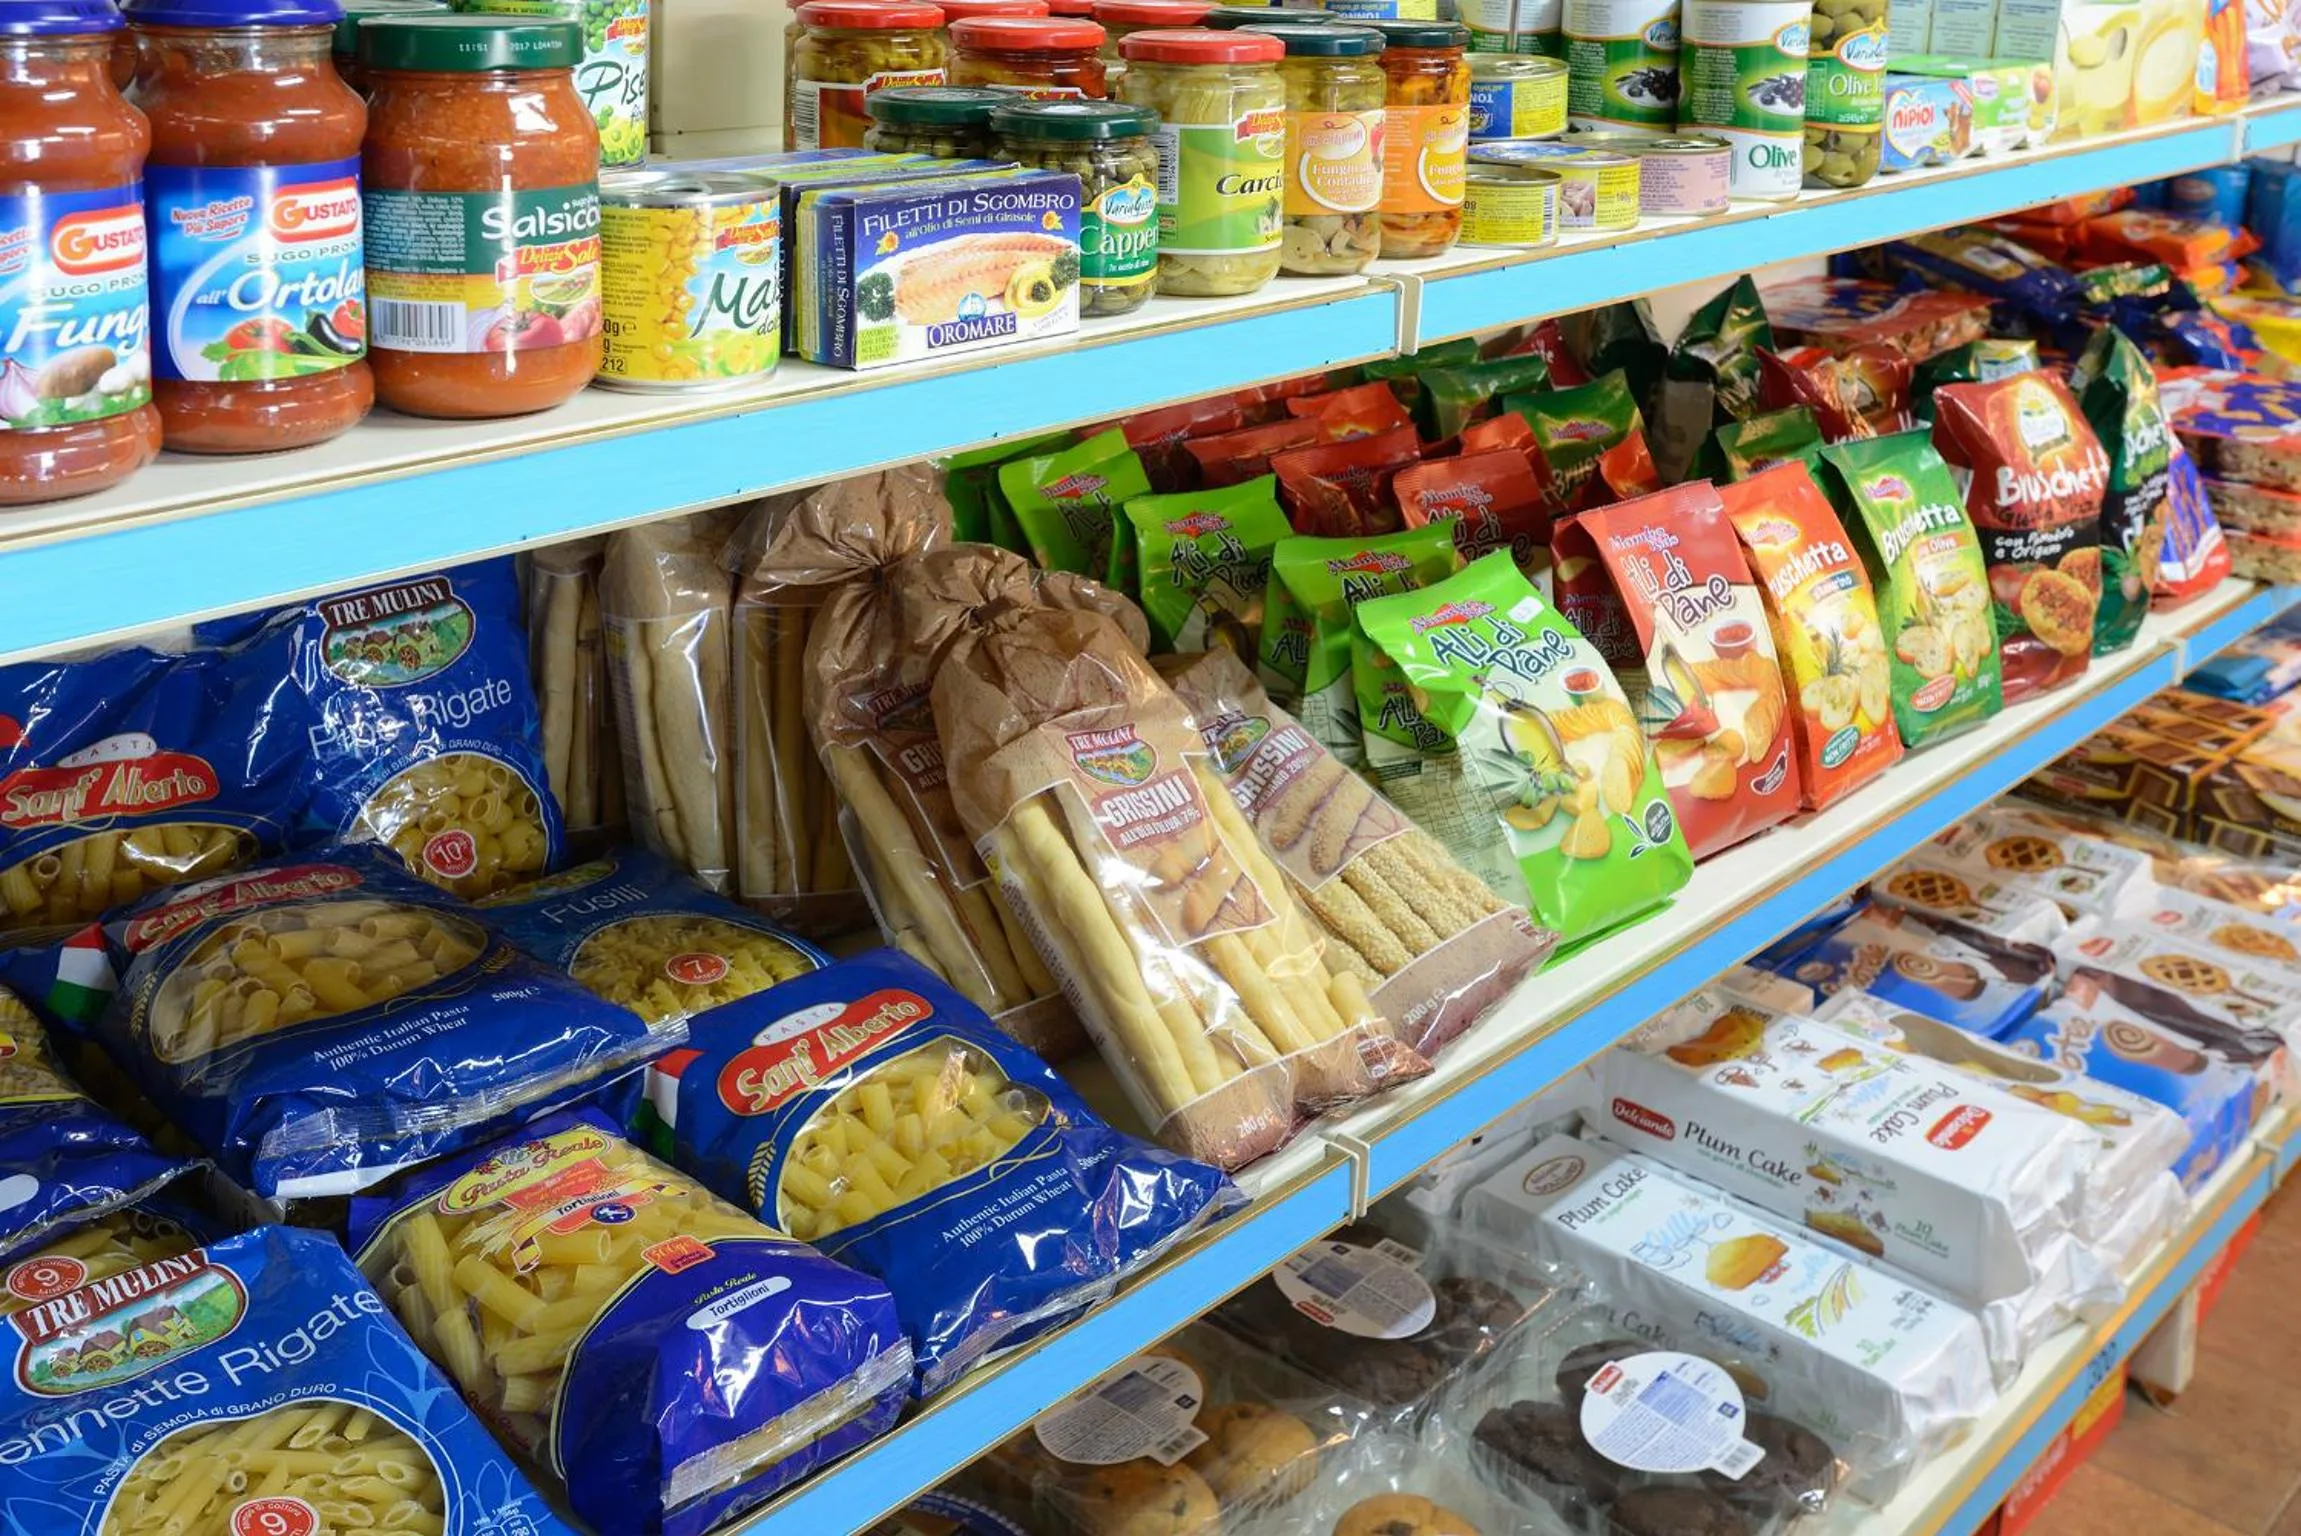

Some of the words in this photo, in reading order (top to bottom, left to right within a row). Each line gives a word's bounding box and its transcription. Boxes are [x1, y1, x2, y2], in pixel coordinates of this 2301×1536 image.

[1749, 143, 1798, 169] Olive
[831, 214, 845, 266] FILETTI
[864, 203, 937, 238] FILETTI
[948, 199, 971, 216] DI
[973, 193, 1076, 213] SGOMBRO
[943, 219, 954, 232] di
[983, 211, 995, 225] di
[837, 270, 848, 284] DI
[833, 287, 850, 359] SGOMBRO
[928, 316, 1016, 347] OROMARE
[1662, 549, 1694, 593] di
[329, 599, 370, 627] TRE
[371, 581, 446, 616] MULINI
[1655, 573, 1736, 636] Pane
[1426, 623, 1490, 669] Ali
[1486, 615, 1529, 649] di
[1486, 626, 1575, 684] Pane
[100, 763, 208, 807] Alberto
[1229, 727, 1310, 810] GRISSINI
[1101, 774, 1193, 829] GRISSINI
[541, 883, 650, 925] Fusilli
[312, 1033, 382, 1063] Authentic
[381, 1017, 429, 1043] Italian
[430, 1004, 471, 1025] Pasta
[327, 1047, 370, 1072] 100%
[369, 1031, 419, 1057] Durum
[420, 1016, 468, 1038] Wheat
[761, 1004, 841, 1043] PASTA
[734, 1040, 818, 1111] Sant'
[822, 998, 922, 1063] Alberto
[1905, 1080, 1960, 1112] Plum
[1683, 1119, 1742, 1162] Plum
[1747, 1148, 1804, 1188] Cake
[1869, 1110, 1920, 1144] Cake
[941, 1200, 1001, 1243] Authentic
[997, 1183, 1038, 1208] Italian
[1034, 1166, 1070, 1187] Pasta
[958, 1222, 994, 1248] 100%
[991, 1201, 1037, 1229] Durum
[1032, 1179, 1073, 1205] Wheat
[1557, 1197, 1612, 1231] Plum
[1601, 1166, 1649, 1199] Cake
[25, 1293, 94, 1339] TRE
[93, 1253, 202, 1311] MULINI
[33, 1268, 60, 1287] 9
[709, 1282, 771, 1318] Tortiglioni
[217, 1289, 384, 1387] Rigate
[92, 1451, 134, 1497] PASTA
[130, 1436, 147, 1454] di
[143, 1406, 211, 1443] SEMOLA
[209, 1405, 225, 1417] di
[225, 1393, 287, 1416] GRANO
[289, 1381, 338, 1397] DURO
[259, 1511, 288, 1536] 9
